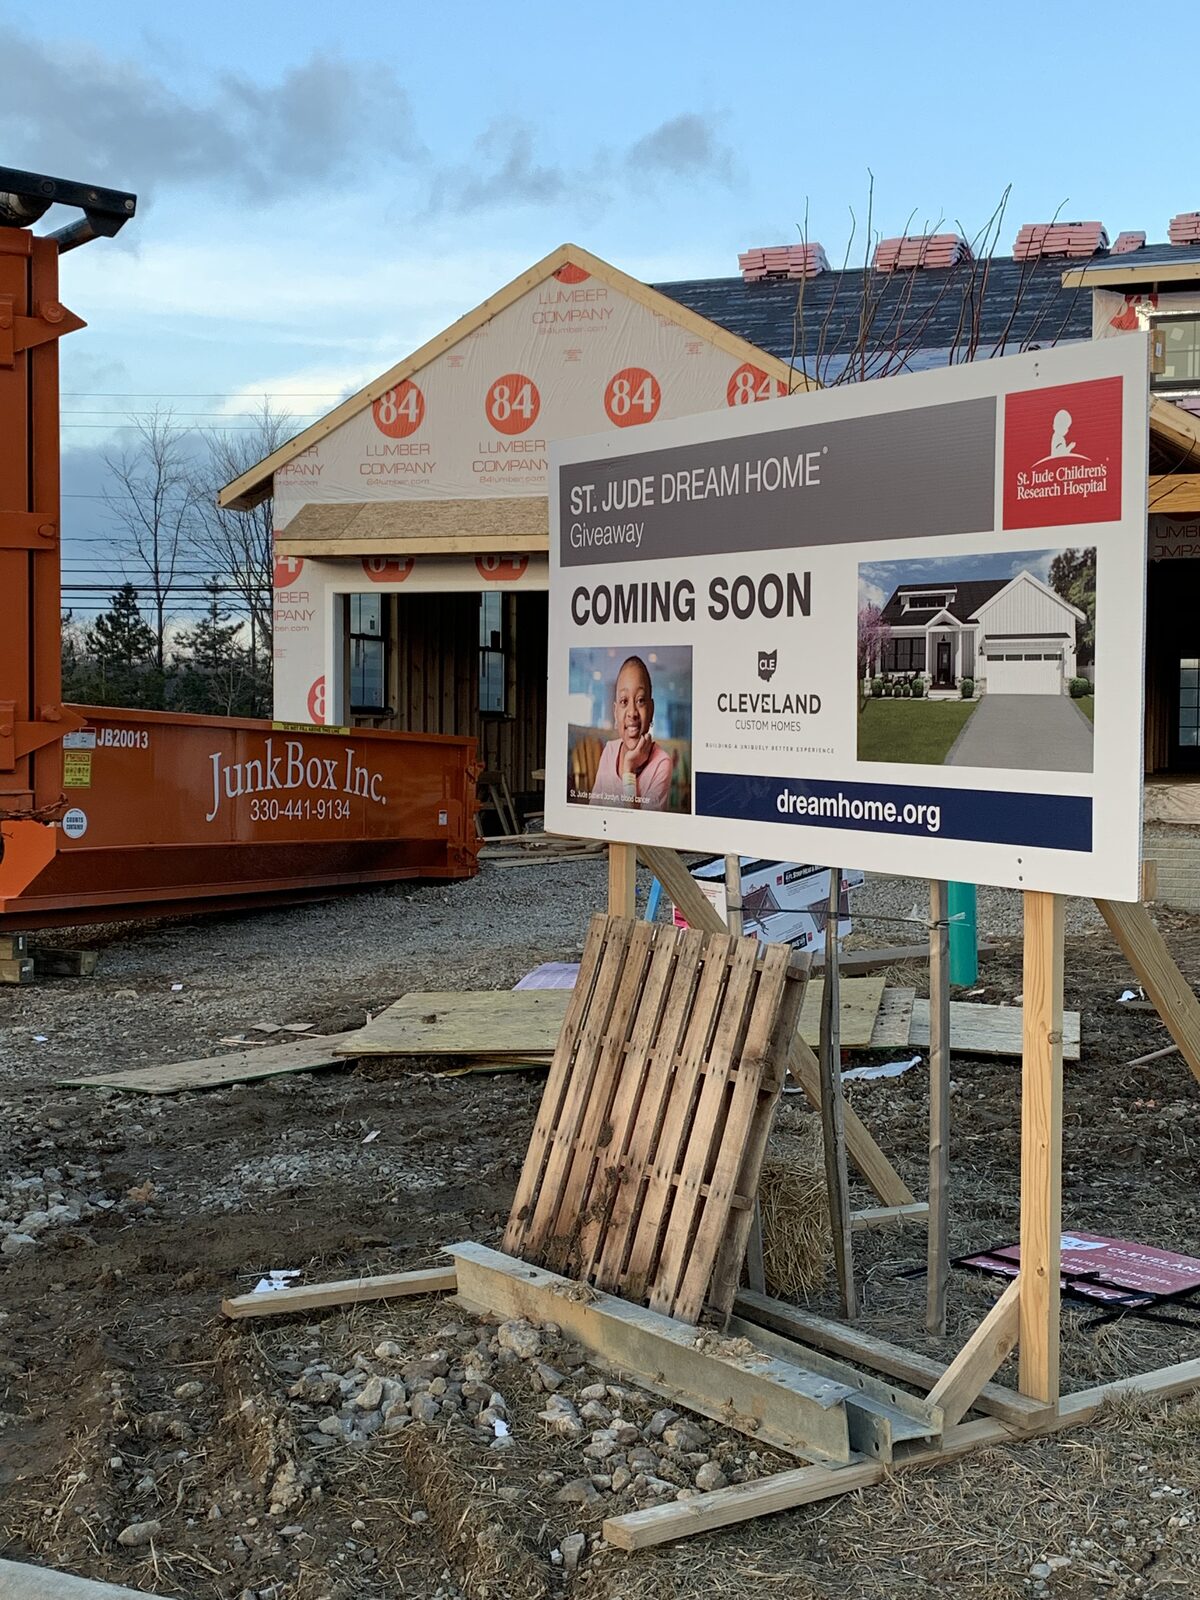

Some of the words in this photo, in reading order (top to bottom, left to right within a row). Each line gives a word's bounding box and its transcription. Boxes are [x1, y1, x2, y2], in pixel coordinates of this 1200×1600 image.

[539, 288, 608, 305] LUMBER
[532, 307, 614, 325] COMPANY
[379, 388, 419, 425] 84
[491, 383, 534, 421] 84
[611, 377, 655, 416] 84
[366, 443, 430, 457] LUMBER
[479, 439, 546, 454] LUMBER
[359, 462, 437, 476] COMPANY
[1017, 471, 1030, 486] St.
[1031, 469, 1055, 487] Jude
[1056, 463, 1108, 482] Children's
[570, 484, 598, 516] ST.
[601, 475, 655, 513] JUDE
[661, 463, 740, 505] DREAM
[1017, 483, 1061, 500] Research
[1063, 477, 1108, 498] Hospital
[570, 521, 645, 549] Giveaway
[571, 578, 696, 627] COMING
[707, 571, 812, 622] SOON
[759, 659, 776, 671] CLE
[717, 692, 822, 715] CLEVELAND
[734, 719, 769, 731] CUSTOM
[770, 720, 802, 732] HOMES
[97, 727, 149, 749] JB20013
[343, 748, 387, 805] Inc.
[250, 799, 350, 821] 330-441-9134
[776, 788, 941, 832] dreamhome.org
[1107, 1247, 1200, 1273] CLEVELAN
